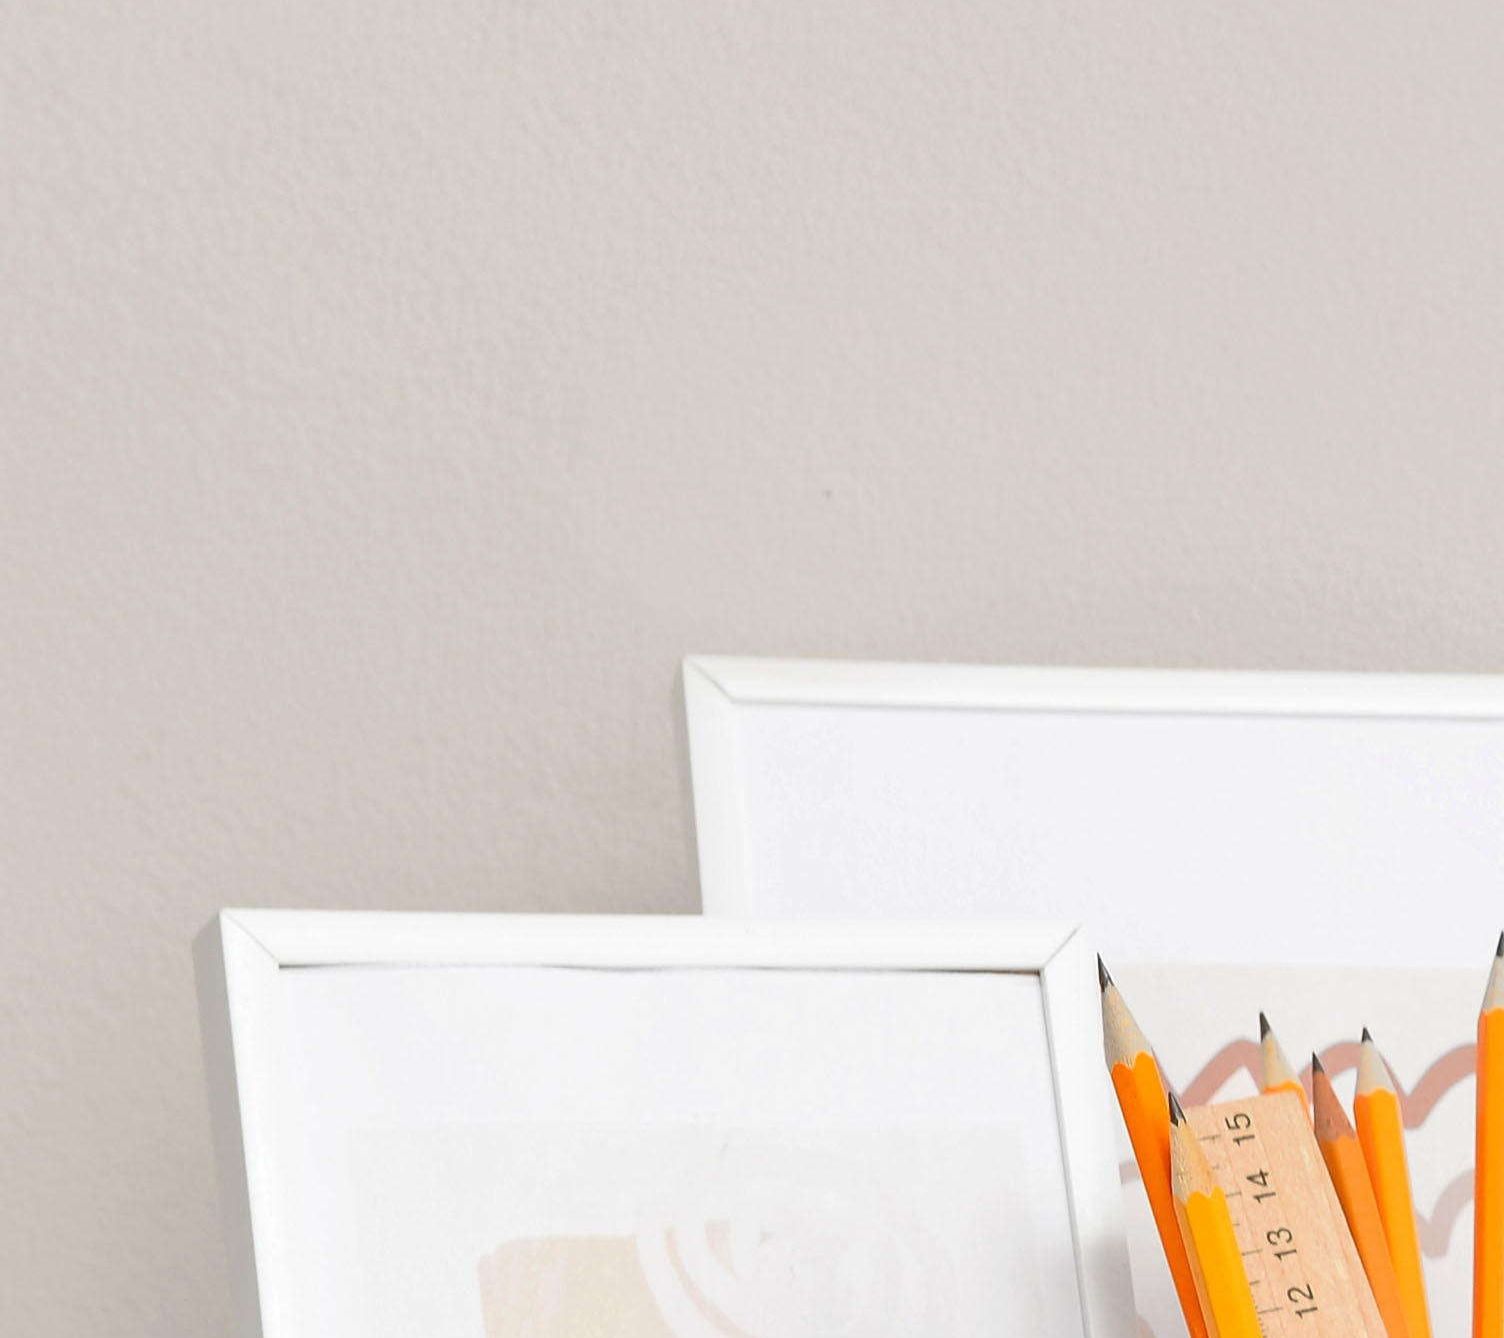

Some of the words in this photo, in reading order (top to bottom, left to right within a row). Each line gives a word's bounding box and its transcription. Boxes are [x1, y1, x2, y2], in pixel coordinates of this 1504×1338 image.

[1224, 1113, 1256, 1147] 15
[1246, 1169, 1276, 1204] 14
[1266, 1227, 1298, 1262] 13
[1286, 1283, 1318, 1319] 12
